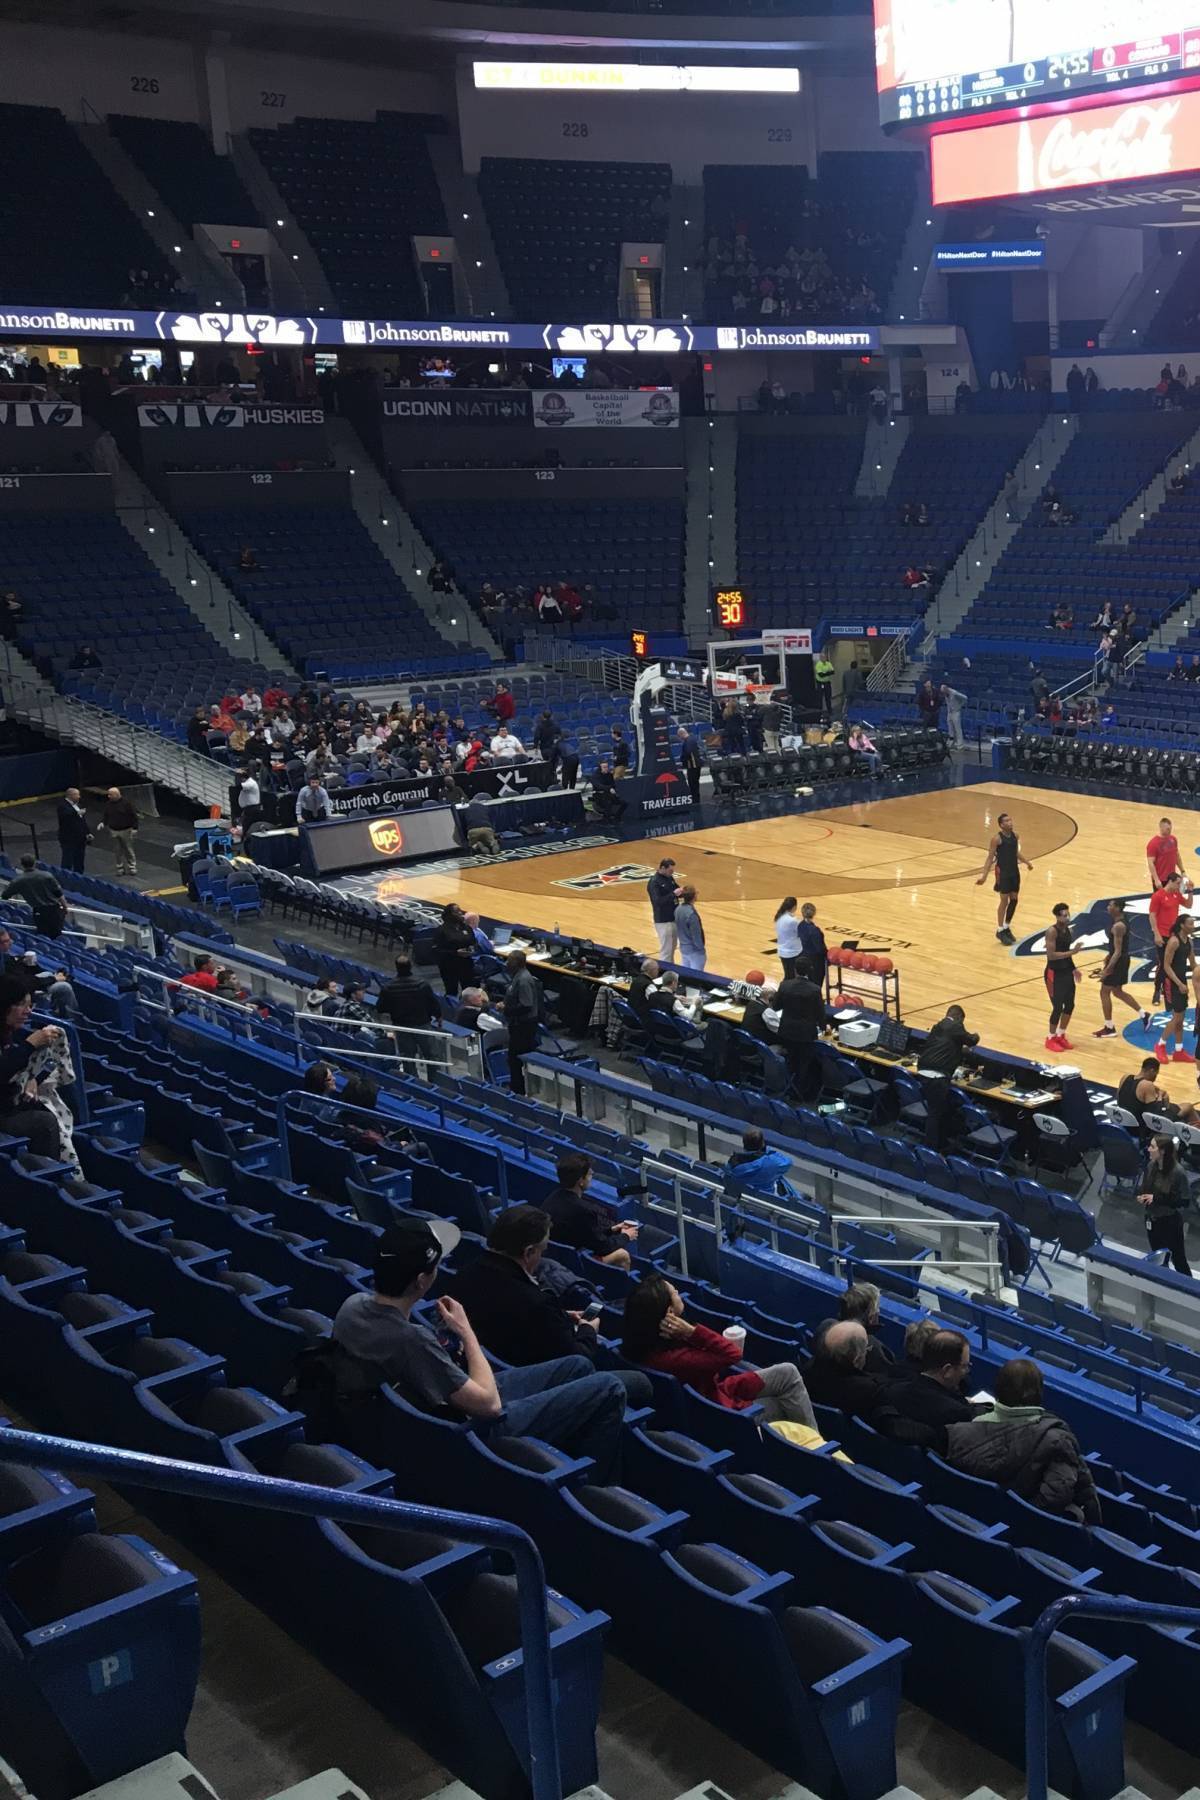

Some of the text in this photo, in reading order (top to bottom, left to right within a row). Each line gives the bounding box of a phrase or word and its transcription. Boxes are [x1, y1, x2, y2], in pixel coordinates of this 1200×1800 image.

[130, 76, 160, 94] 226
[260, 91, 287, 108] 227
[562, 122, 589, 138] 228
[941, 368, 960, 377] 124
[244, 408, 325, 424] HUSKIES
[383, 400, 452, 417] UCONN
[251, 474, 273, 484] 122
[535, 470, 555, 481] 123
[717, 591, 742, 604] 24:55
[721, 603, 741, 624] 30
[496, 770, 528, 797] XL
[382, 786, 430, 804] Courant
[642, 795, 693, 810] TRAVELERS
[373, 828, 400, 850] ups
[825, 925, 893, 943] CENTER
[100, 1656, 120, 1687] P
